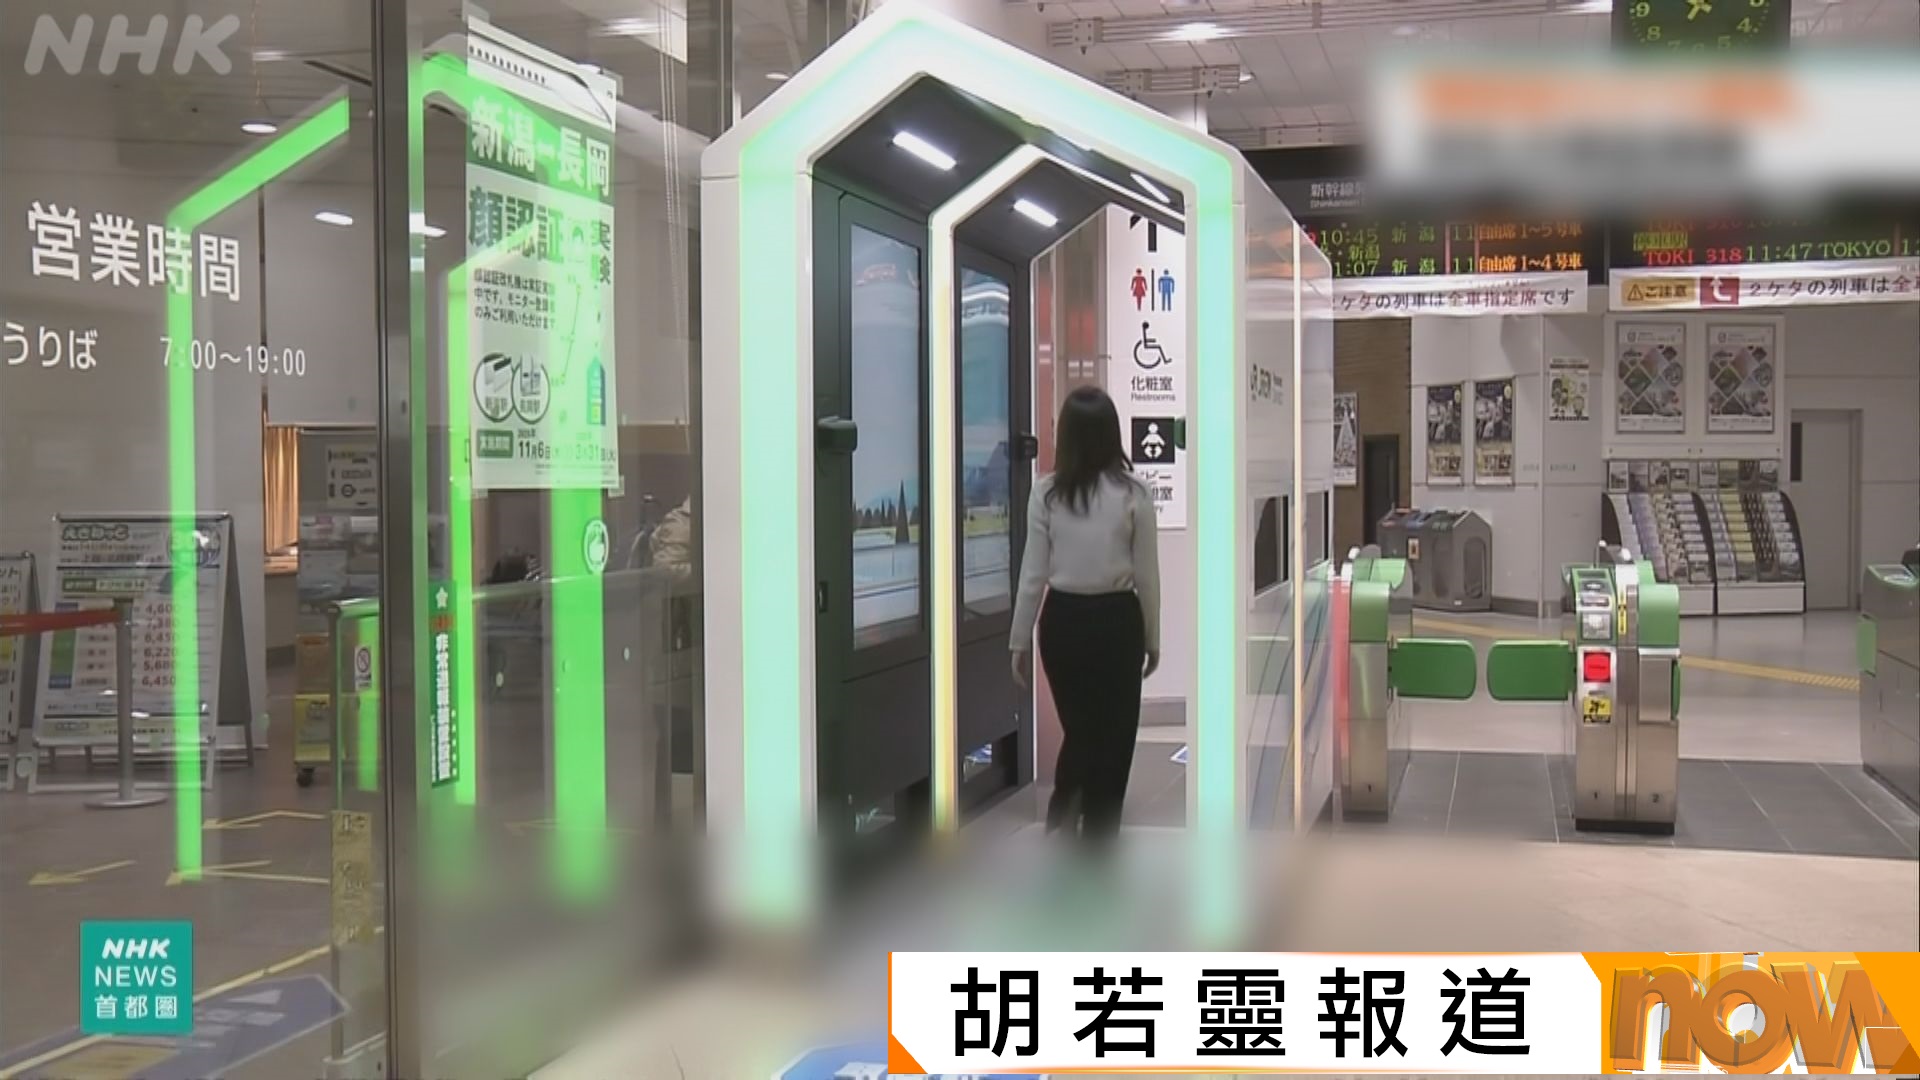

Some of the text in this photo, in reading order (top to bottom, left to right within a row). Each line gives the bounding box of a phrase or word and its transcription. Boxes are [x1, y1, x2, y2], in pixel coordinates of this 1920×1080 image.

[1636, 3, 1650, 17] 9
[1646, 25, 1661, 41] 8
[1737, 17, 1751, 33] 4
[1320, 228, 1379, 245] 10:45
[27, 201, 241, 302] 営業時間
[1644, 250, 1695, 266] TOKI
[1746, 243, 1813, 262] 11:47
[1819, 240, 1890, 258] TOKYO
[1391, 258, 1436, 275] 新潟
[1332, 288, 1575, 311] ケタの列車は全車指定席です
[1130, 375, 1173, 391] 化粧室
[1131, 392, 1176, 401] Restrooms
